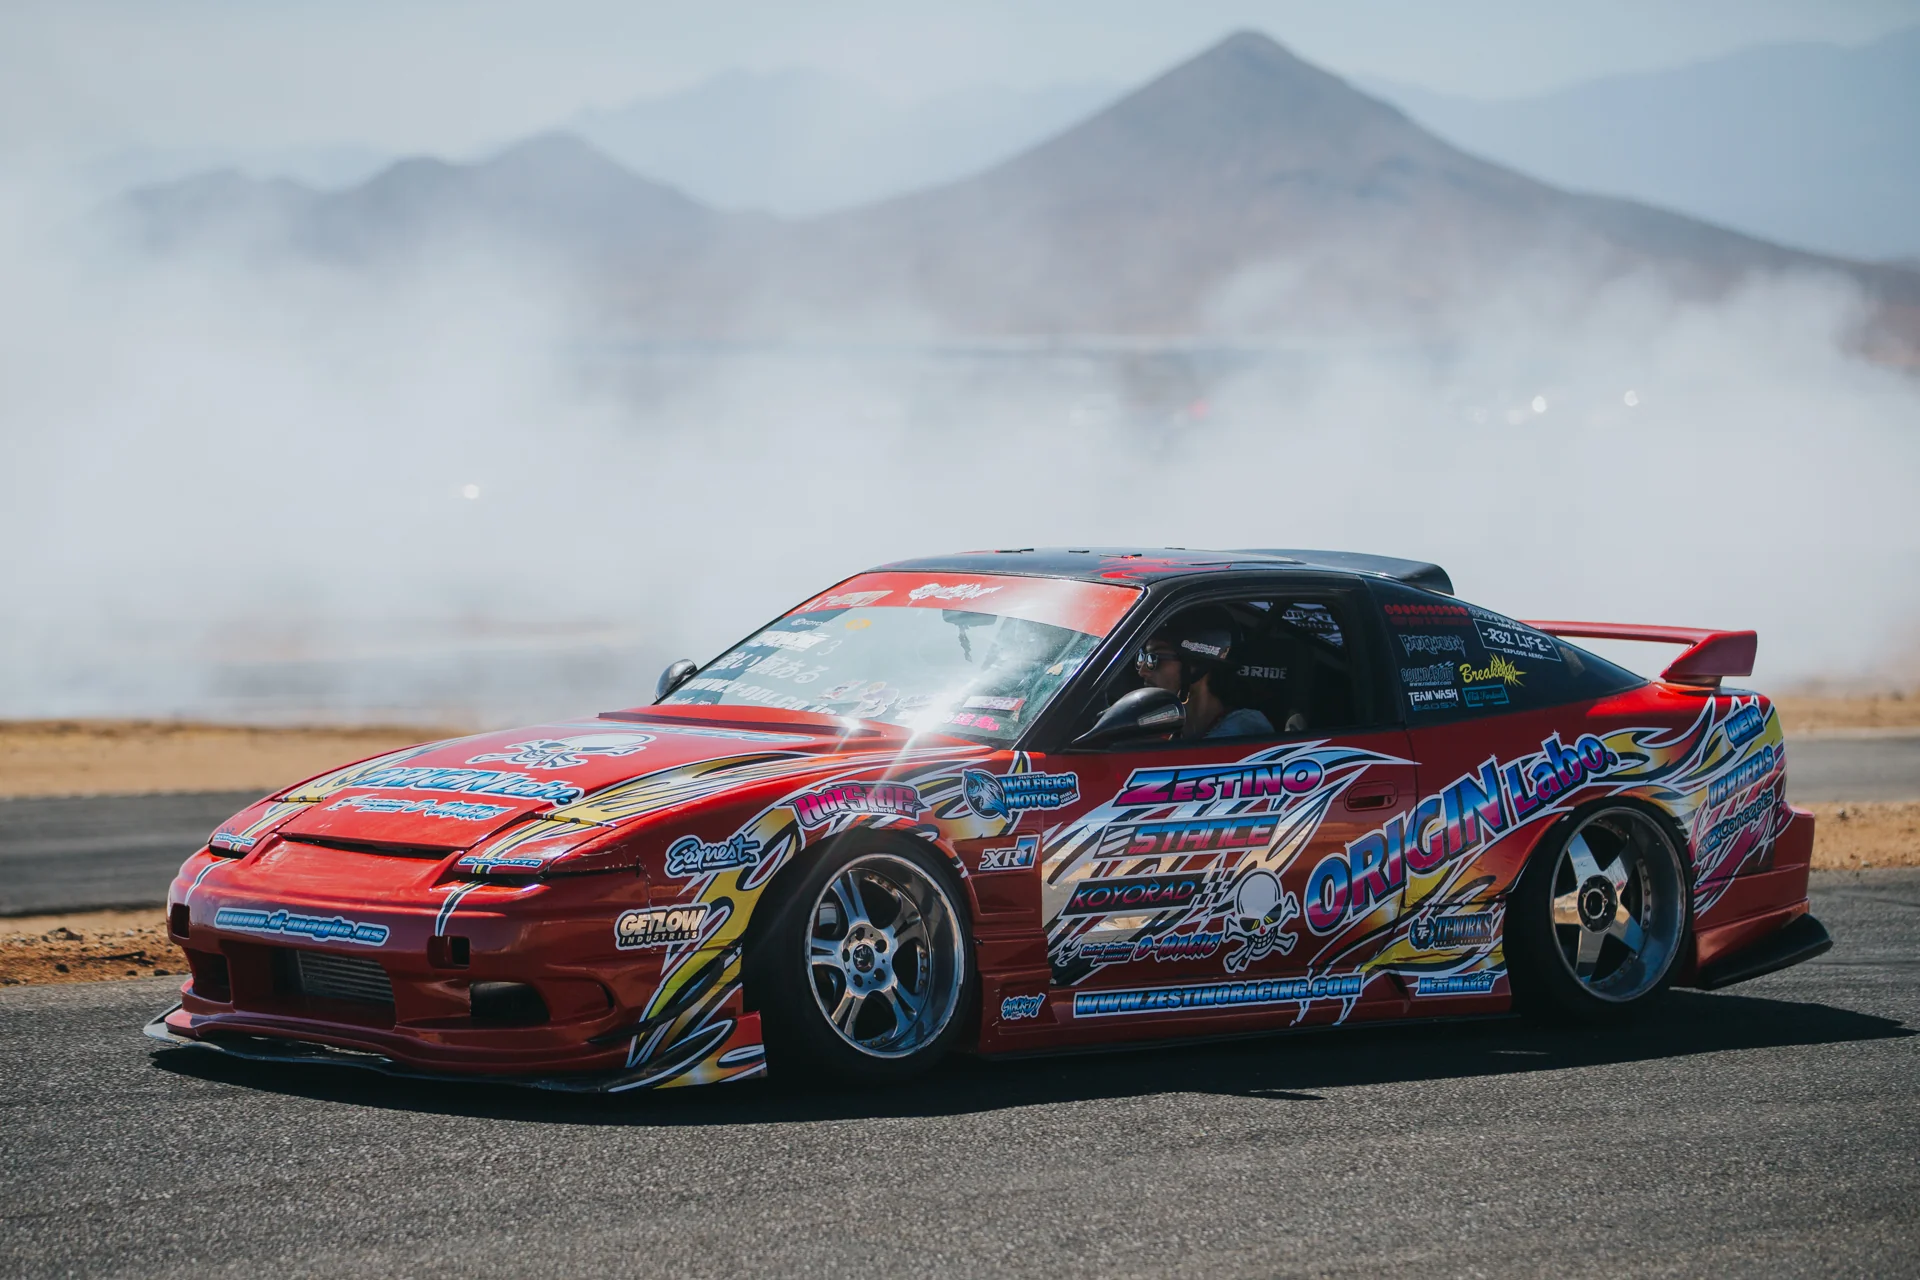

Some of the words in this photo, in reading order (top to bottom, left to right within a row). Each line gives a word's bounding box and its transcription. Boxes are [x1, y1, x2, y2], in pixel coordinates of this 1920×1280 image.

[1237, 665, 1287, 680] BRIDE
[1408, 691, 1433, 706] TEAM
[1432, 688, 1459, 702] WASH
[1725, 705, 1763, 741] WEIR
[351, 767, 508, 794] ORIGIN
[1112, 758, 1324, 807] ZESTINO
[1005, 792, 1060, 808] MOTORS
[1127, 815, 1281, 855] STANCE
[1306, 757, 1504, 931] ORIGIN
[981, 841, 1036, 868] XR1
[1070, 880, 1196, 908] KOYORAD
[216, 909, 388, 943] www.d-magic.us
[620, 908, 707, 936] GETLOW
[621, 930, 698, 945] INDUSTRIES
[1075, 975, 1362, 1015] WWW.ZESTINORACING.COM
